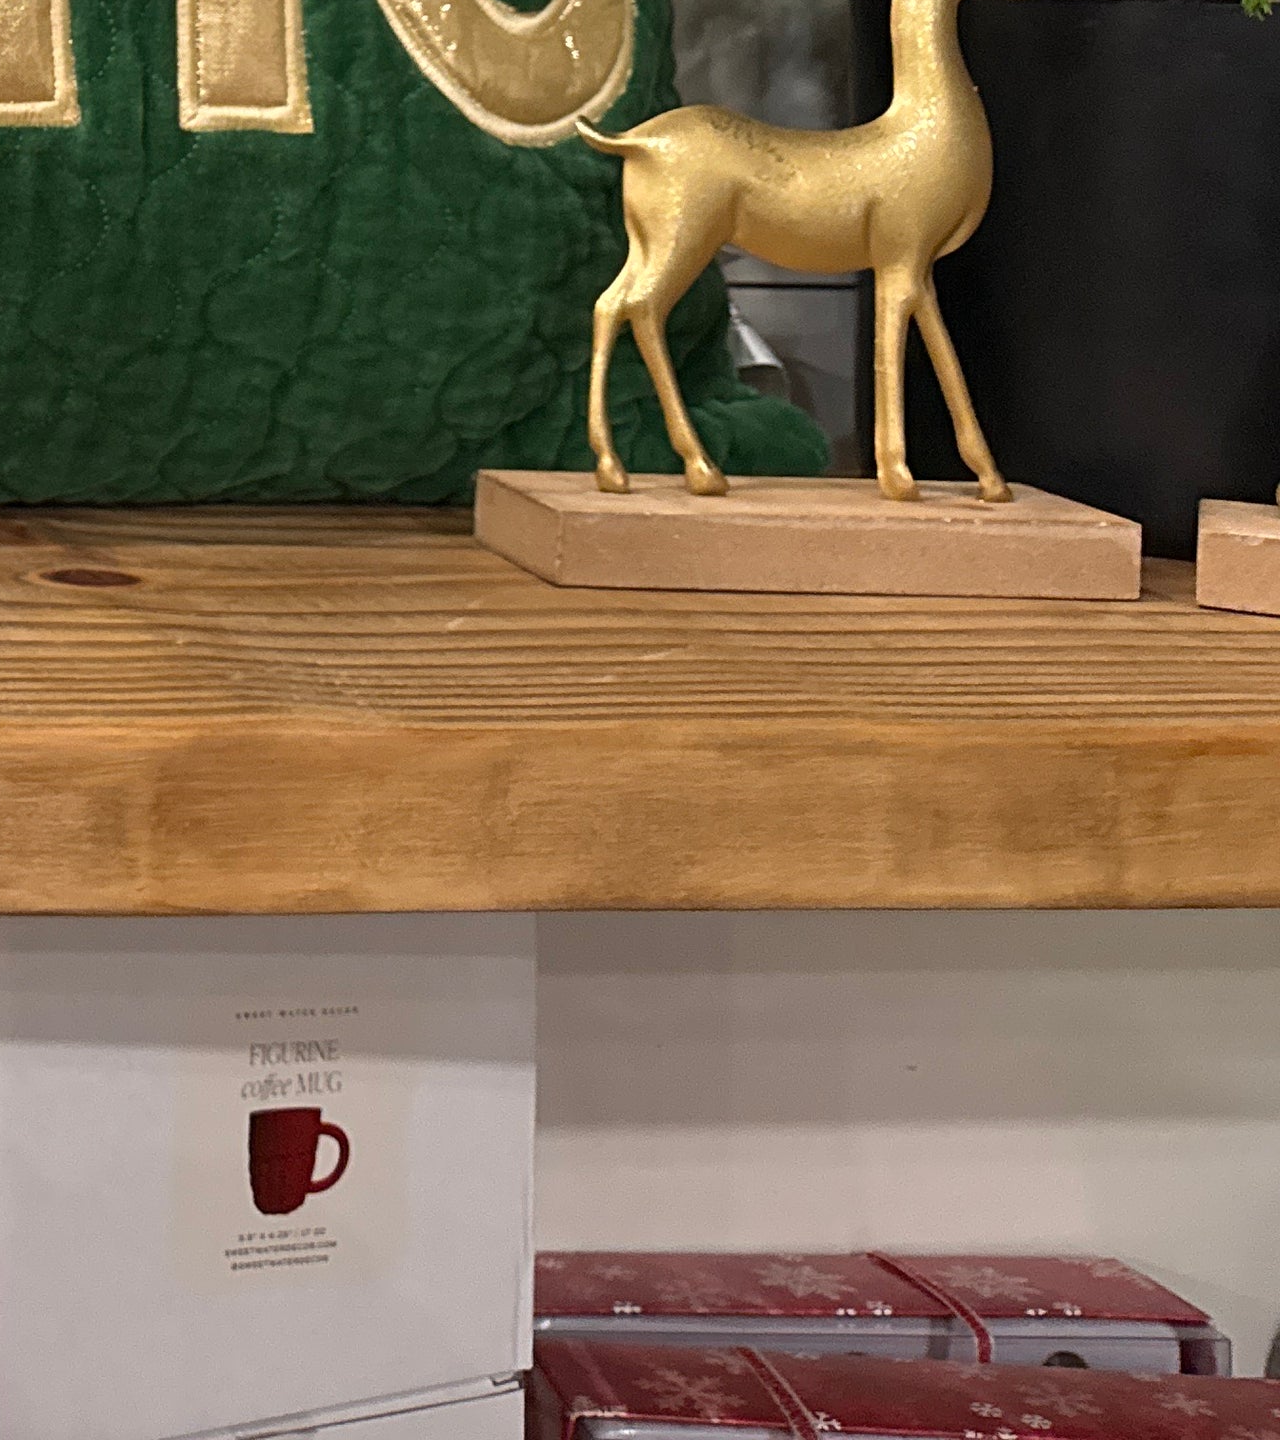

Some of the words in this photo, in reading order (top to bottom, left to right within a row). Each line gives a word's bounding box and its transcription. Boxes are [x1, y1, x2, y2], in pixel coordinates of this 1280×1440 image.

[249, 1038, 340, 1066] FIGURINE
[241, 1073, 292, 1101] coffee
[295, 1070, 343, 1095] MUG
